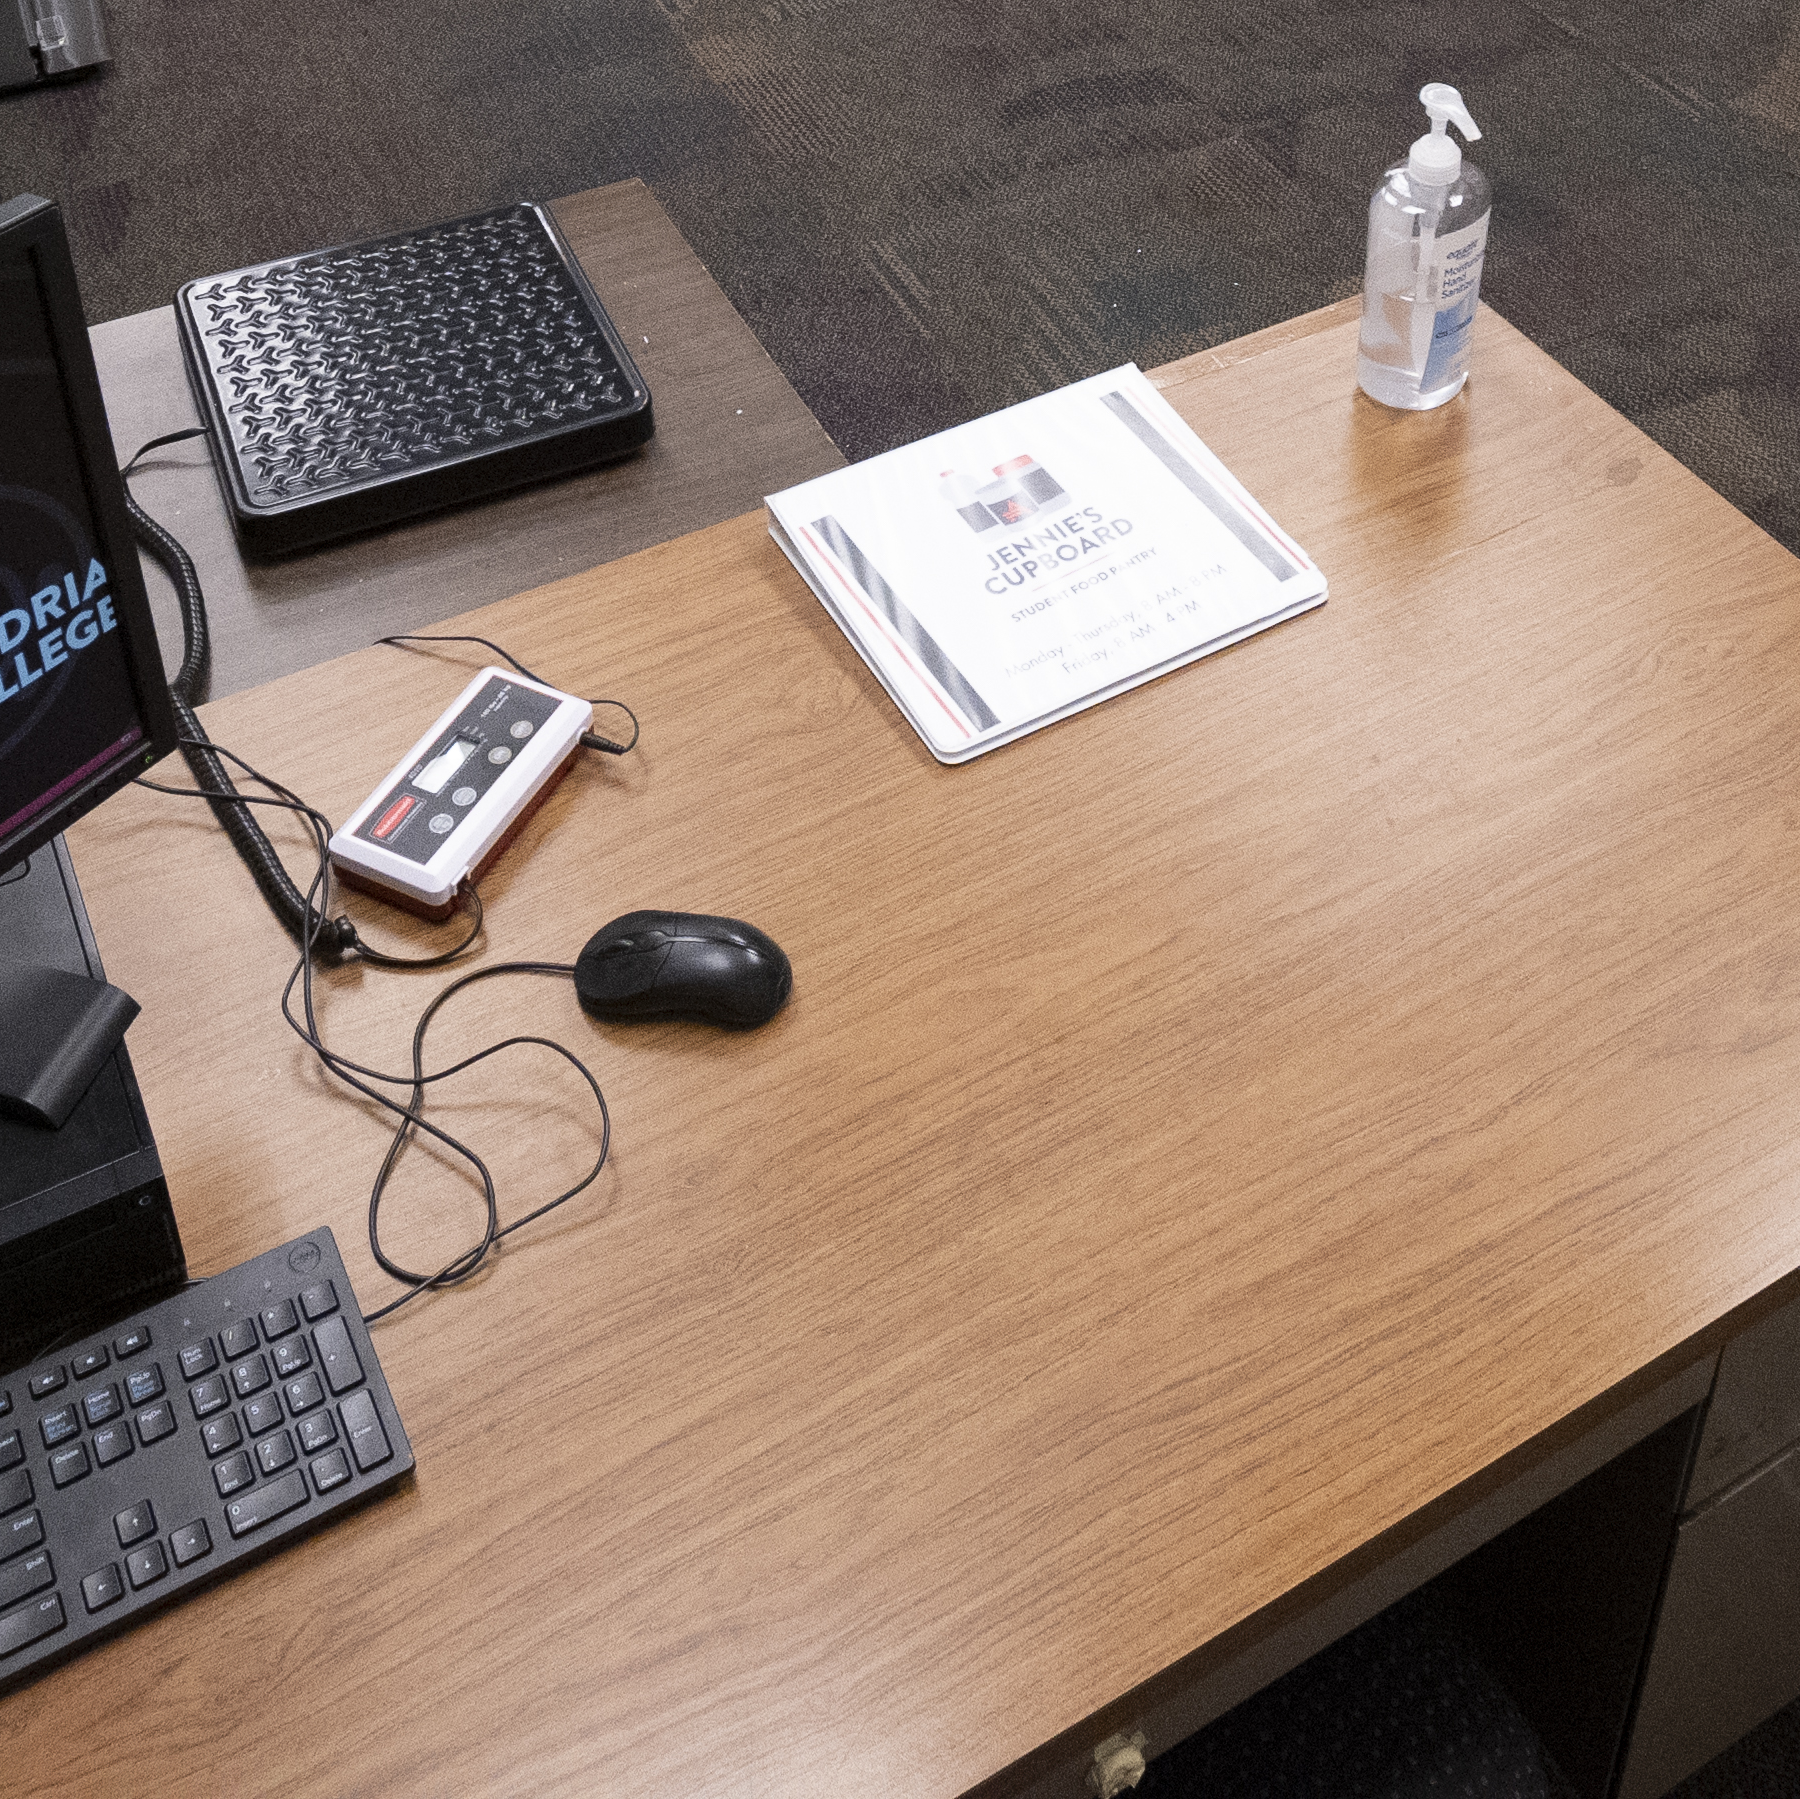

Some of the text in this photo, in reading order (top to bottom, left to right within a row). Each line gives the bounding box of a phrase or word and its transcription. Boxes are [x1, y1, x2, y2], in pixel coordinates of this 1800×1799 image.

[1443, 273, 1468, 289] Hand
[984, 518, 1134, 595] CUPBOARD
[986, 506, 1103, 571] JENNIE'S
[1011, 547, 1157, 623] STUDENT FOOD PANTRY
[1005, 646, 1065, 678] Monday
[1156, 586, 1182, 605] AM
[1202, 563, 1227, 582] PM
[1130, 623, 1156, 642] AM
[1166, 611, 1176, 624] 4
[1177, 599, 1202, 618] PM
